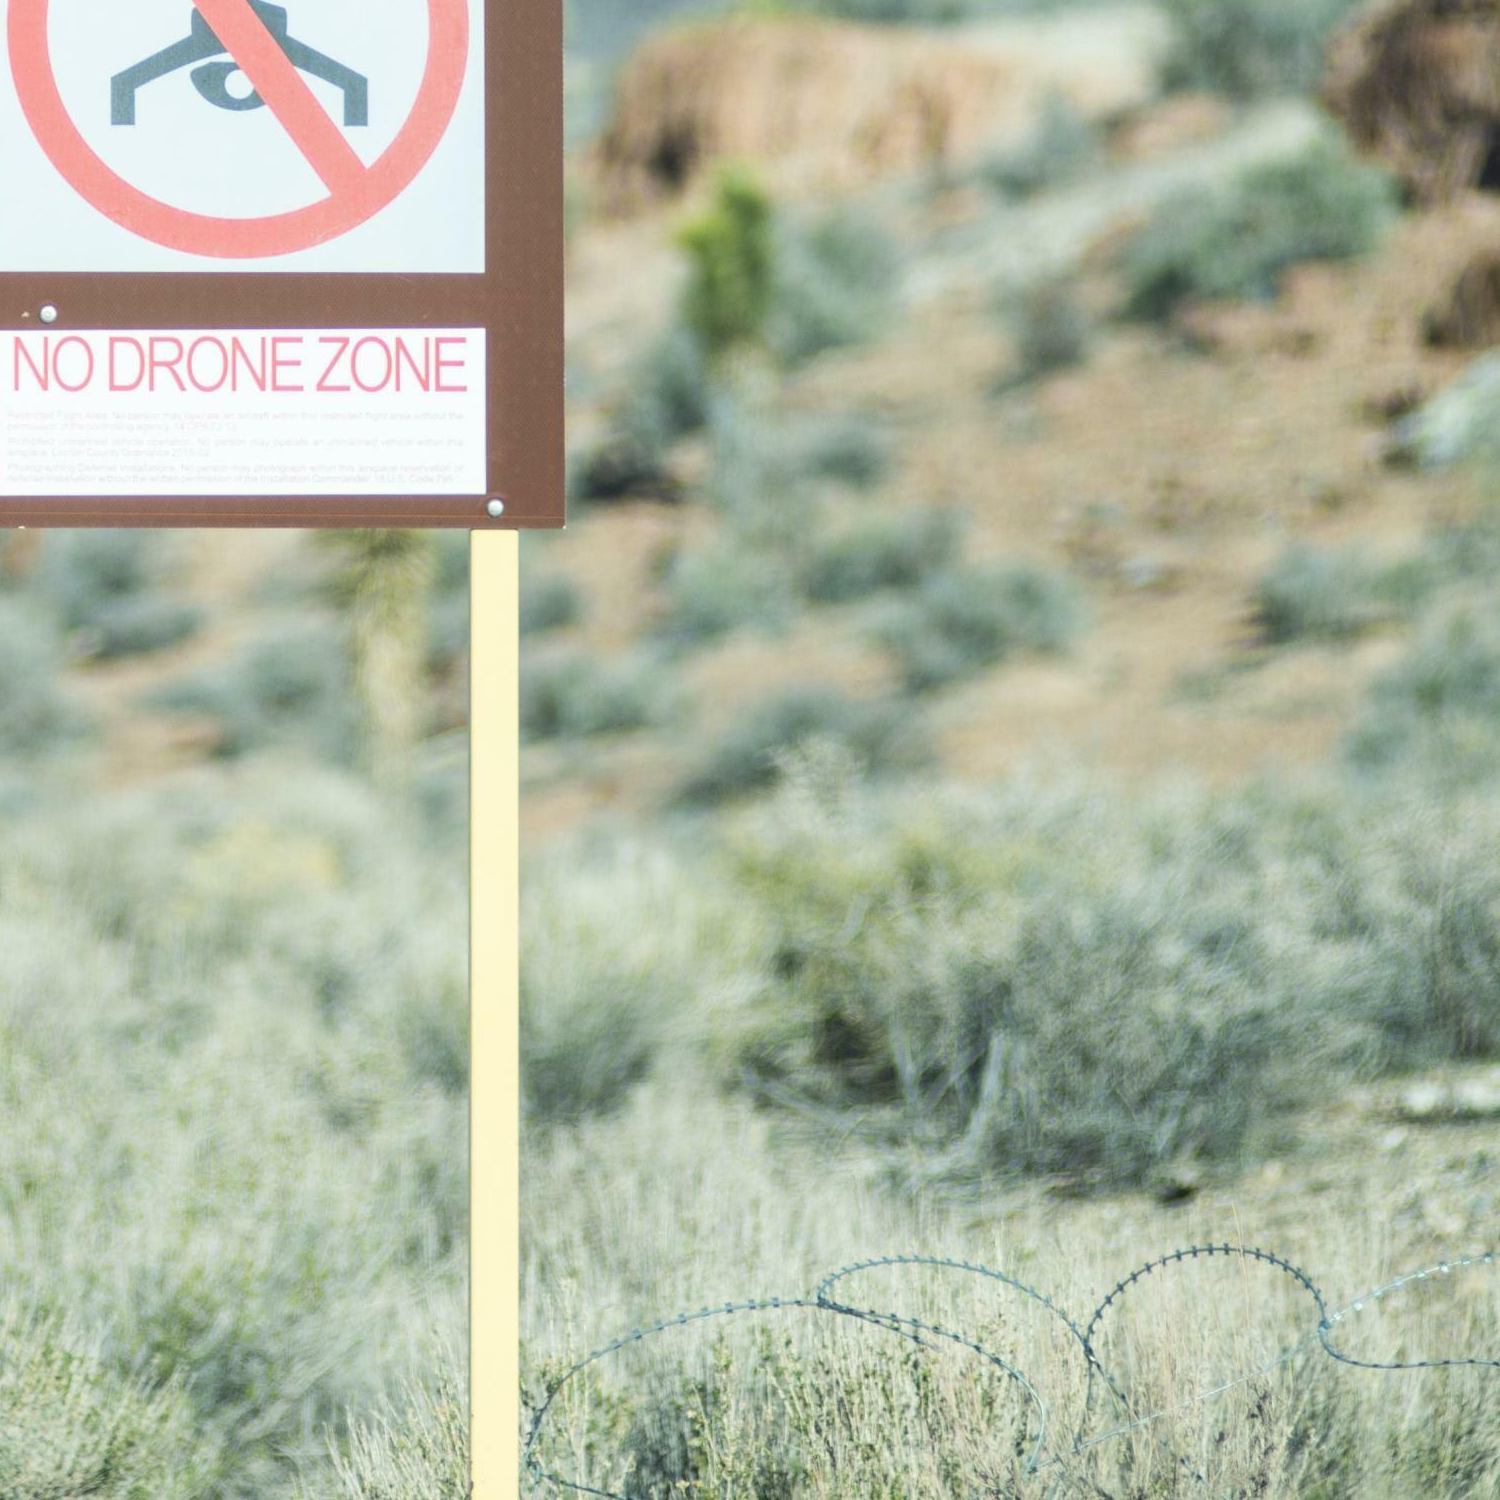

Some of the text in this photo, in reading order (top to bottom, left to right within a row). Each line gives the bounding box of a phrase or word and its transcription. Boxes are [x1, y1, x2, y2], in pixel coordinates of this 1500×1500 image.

[12, 335, 468, 393] NO DRONE ZONE
